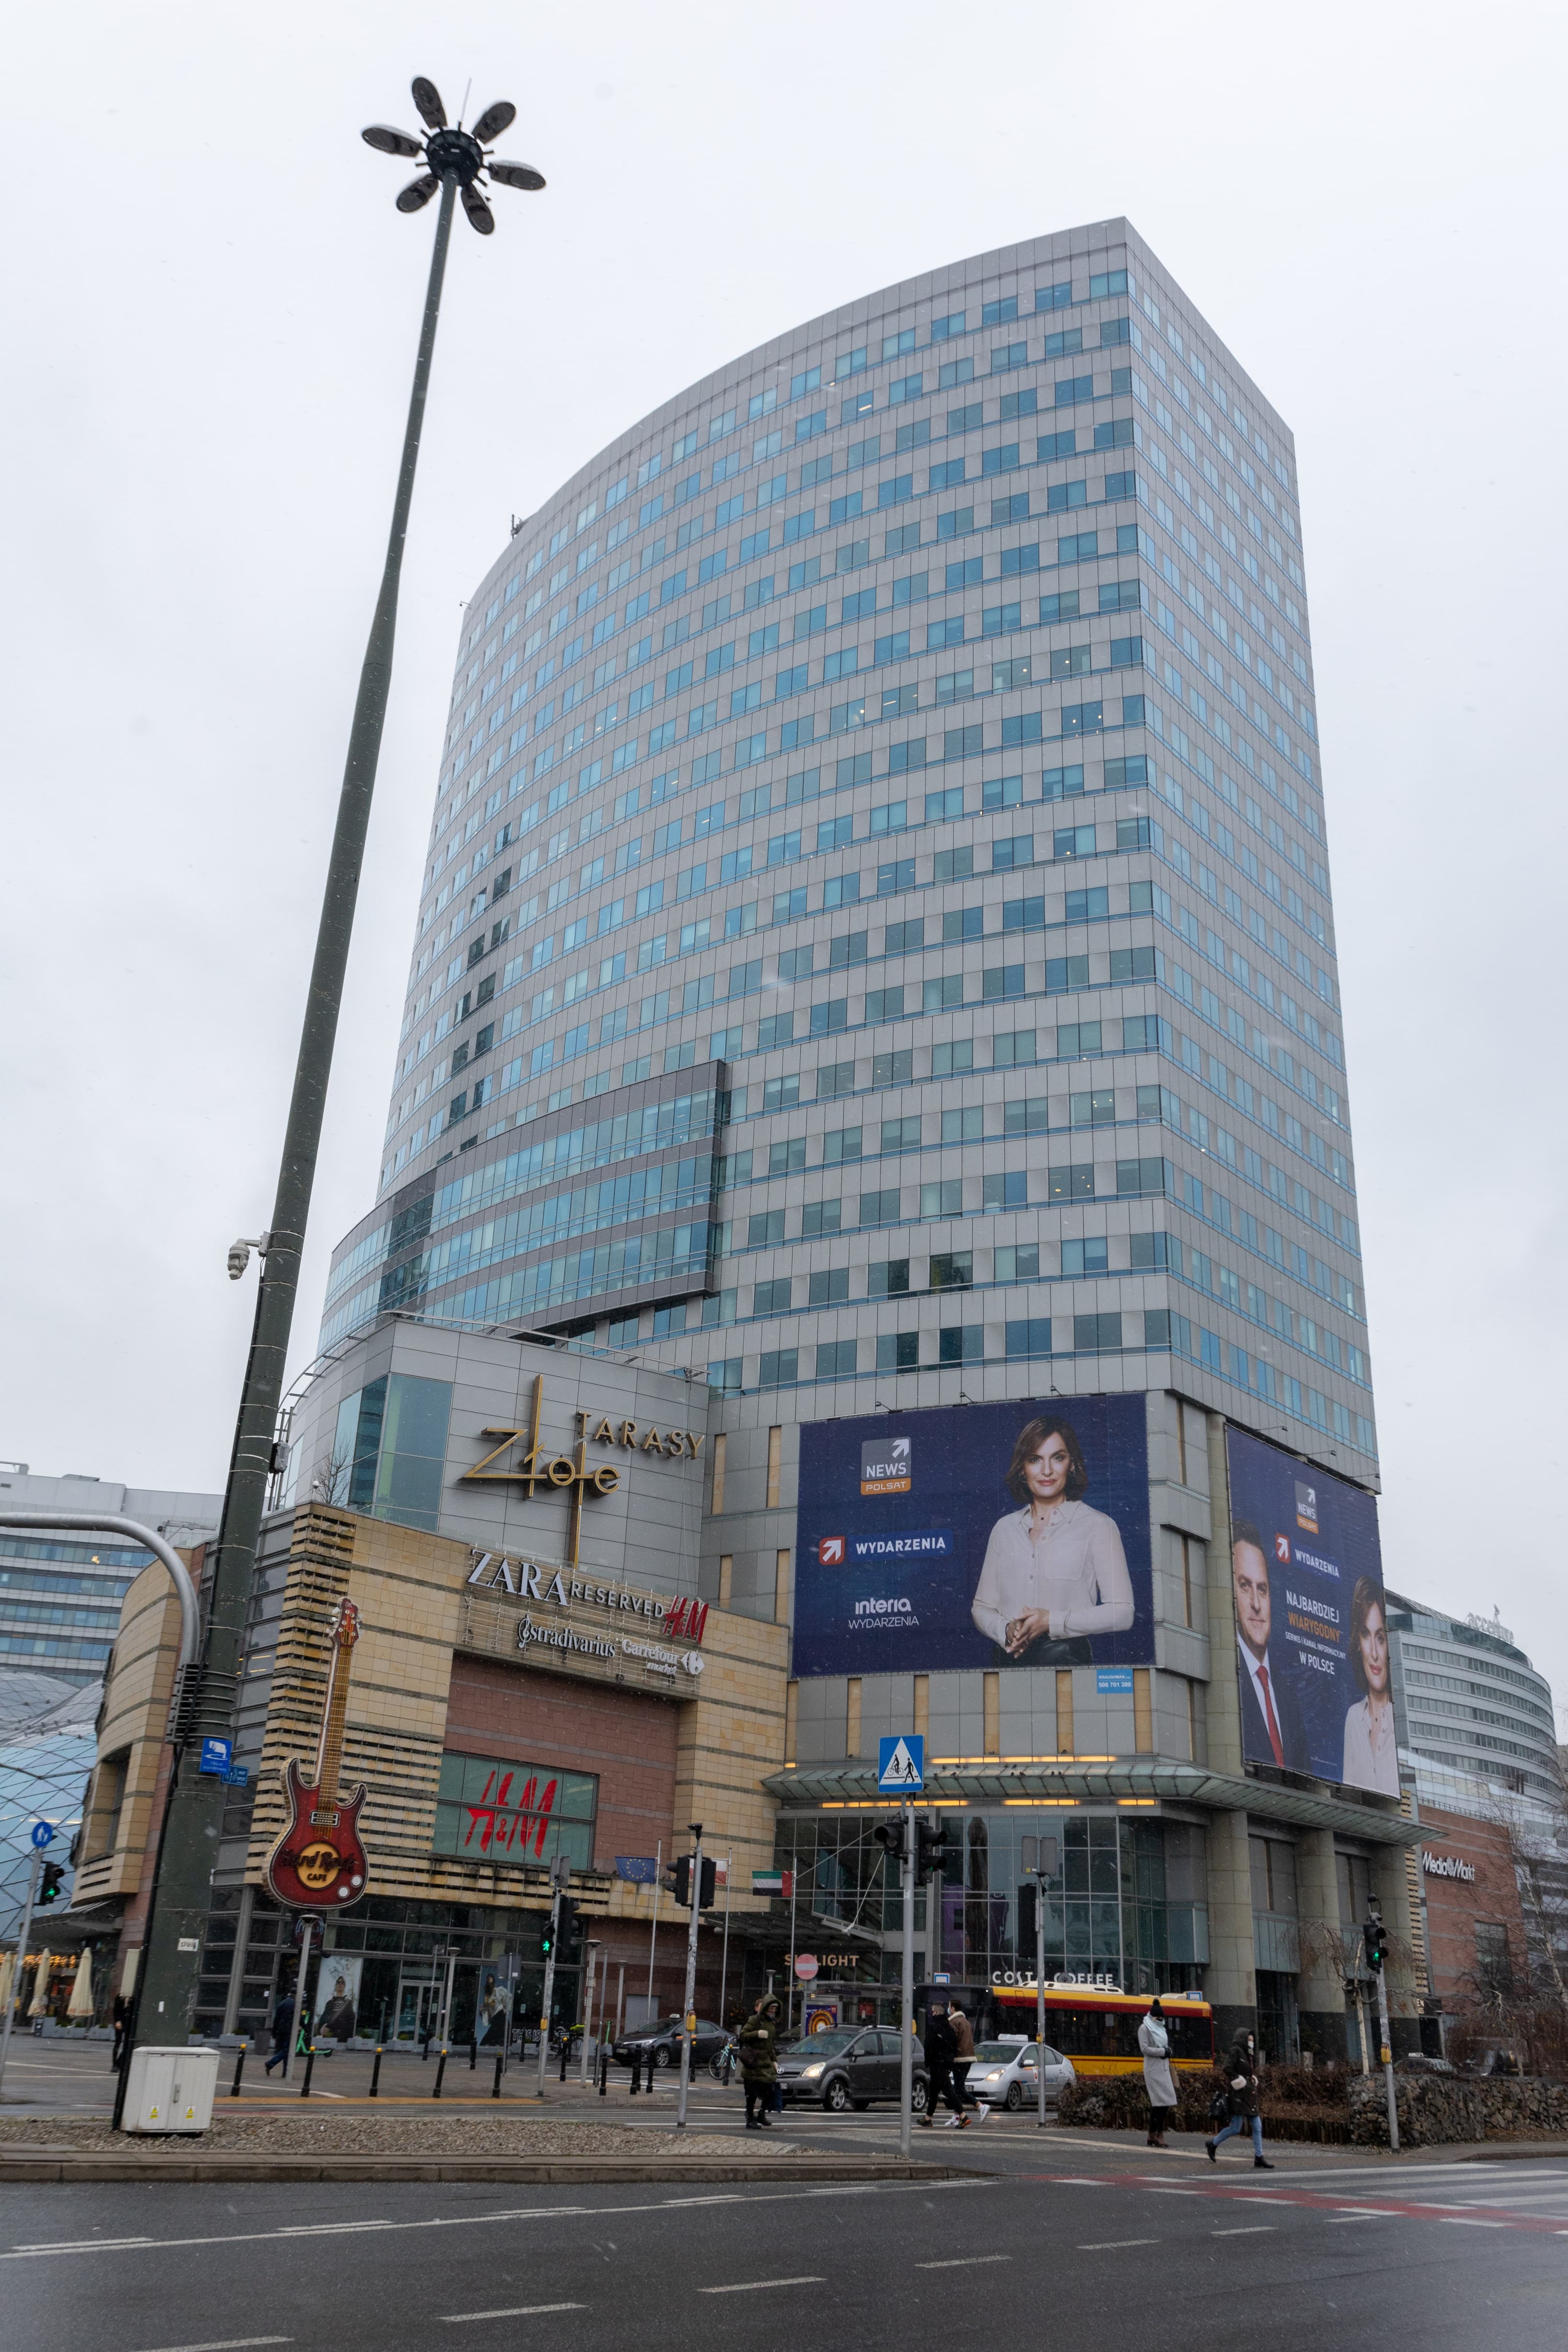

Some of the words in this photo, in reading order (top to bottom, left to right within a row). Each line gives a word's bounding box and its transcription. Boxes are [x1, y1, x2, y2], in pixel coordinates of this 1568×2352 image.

[576, 1411, 704, 1460] TARASY
[866, 1462, 907, 1478] NEWS
[866, 1481, 906, 1491] POLSAT
[1298, 1502, 1316, 1519] NEWS
[1299, 1518, 1317, 1530] POLSAT
[856, 1537, 945, 1555] WYDARZENIA
[1294, 1548, 1340, 1578] WYDARZENIA
[468, 1549, 569, 1606] ZARA
[571, 1580, 664, 1618] RESERVED
[855, 1598, 911, 1614] interia
[1285, 1590, 1339, 1623] NAJBARDZIEJ
[662, 1595, 709, 1645] H&M
[848, 1615, 919, 1629] WYDARZENIA
[1288, 1611, 1340, 1643] WIARYGODNY
[530, 1625, 616, 1658] stradivarius
[622, 1638, 680, 1664] Carrefour
[1285, 1631, 1301, 1643] SERWIS
[1303, 1637, 1317, 1649] KANAŁ
[1317, 1643, 1346, 1660] INFORMACYJNY
[647, 1662, 677, 1675] market
[1299, 1650, 1306, 1665] W
[1307, 1654, 1335, 1675] POLSCE
[464, 1770, 558, 1859] H&M
[277, 1848, 321, 1869] Hard
[319, 1851, 357, 1873] Rock
[307, 1873, 327, 1881] CAFE
[784, 1954, 859, 1967] SLIGHT
[992, 1971, 1038, 1985] COST
[512, 2029, 531, 2041] THS
